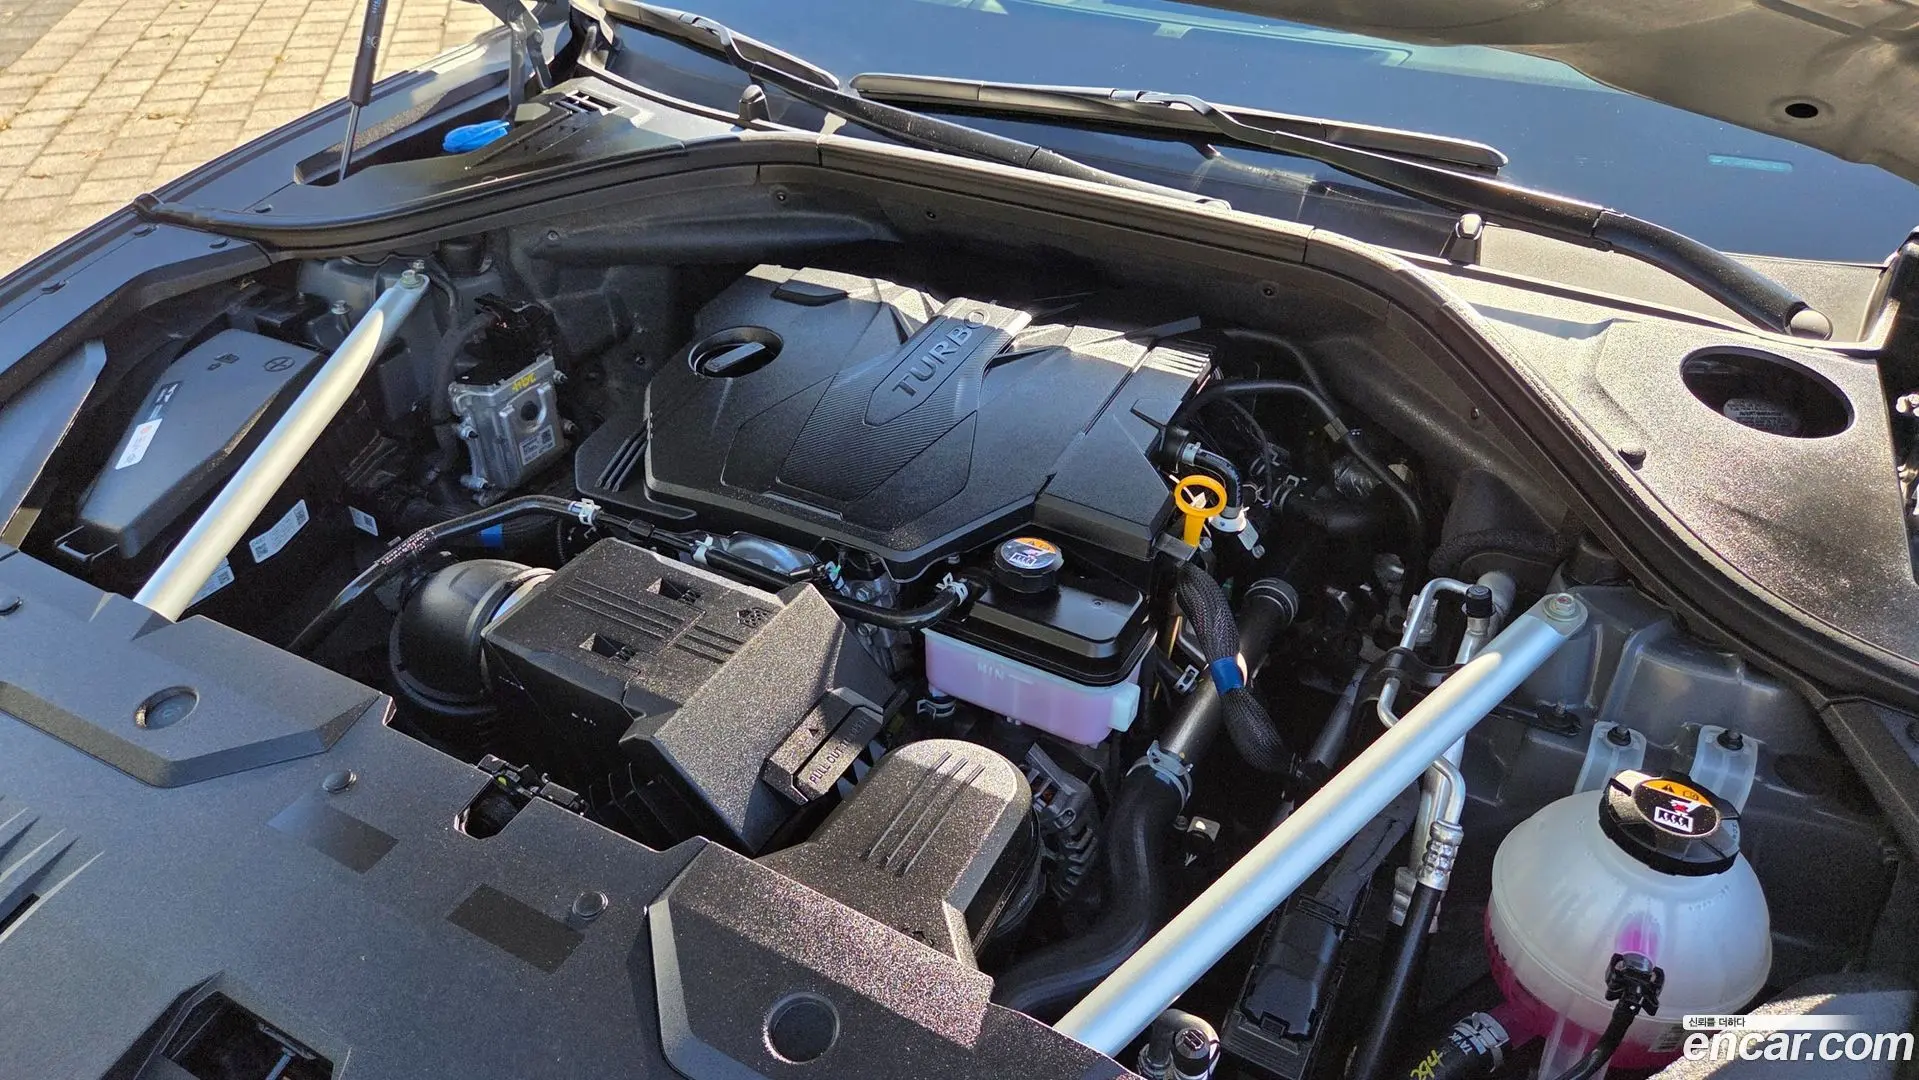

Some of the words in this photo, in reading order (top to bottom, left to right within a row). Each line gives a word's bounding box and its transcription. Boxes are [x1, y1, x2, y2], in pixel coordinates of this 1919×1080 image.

[892, 310, 989, 397] TURBO
[977, 661, 1005, 681] MIN
[809, 763, 831, 784] PULL
[826, 745, 844, 764] OUT
